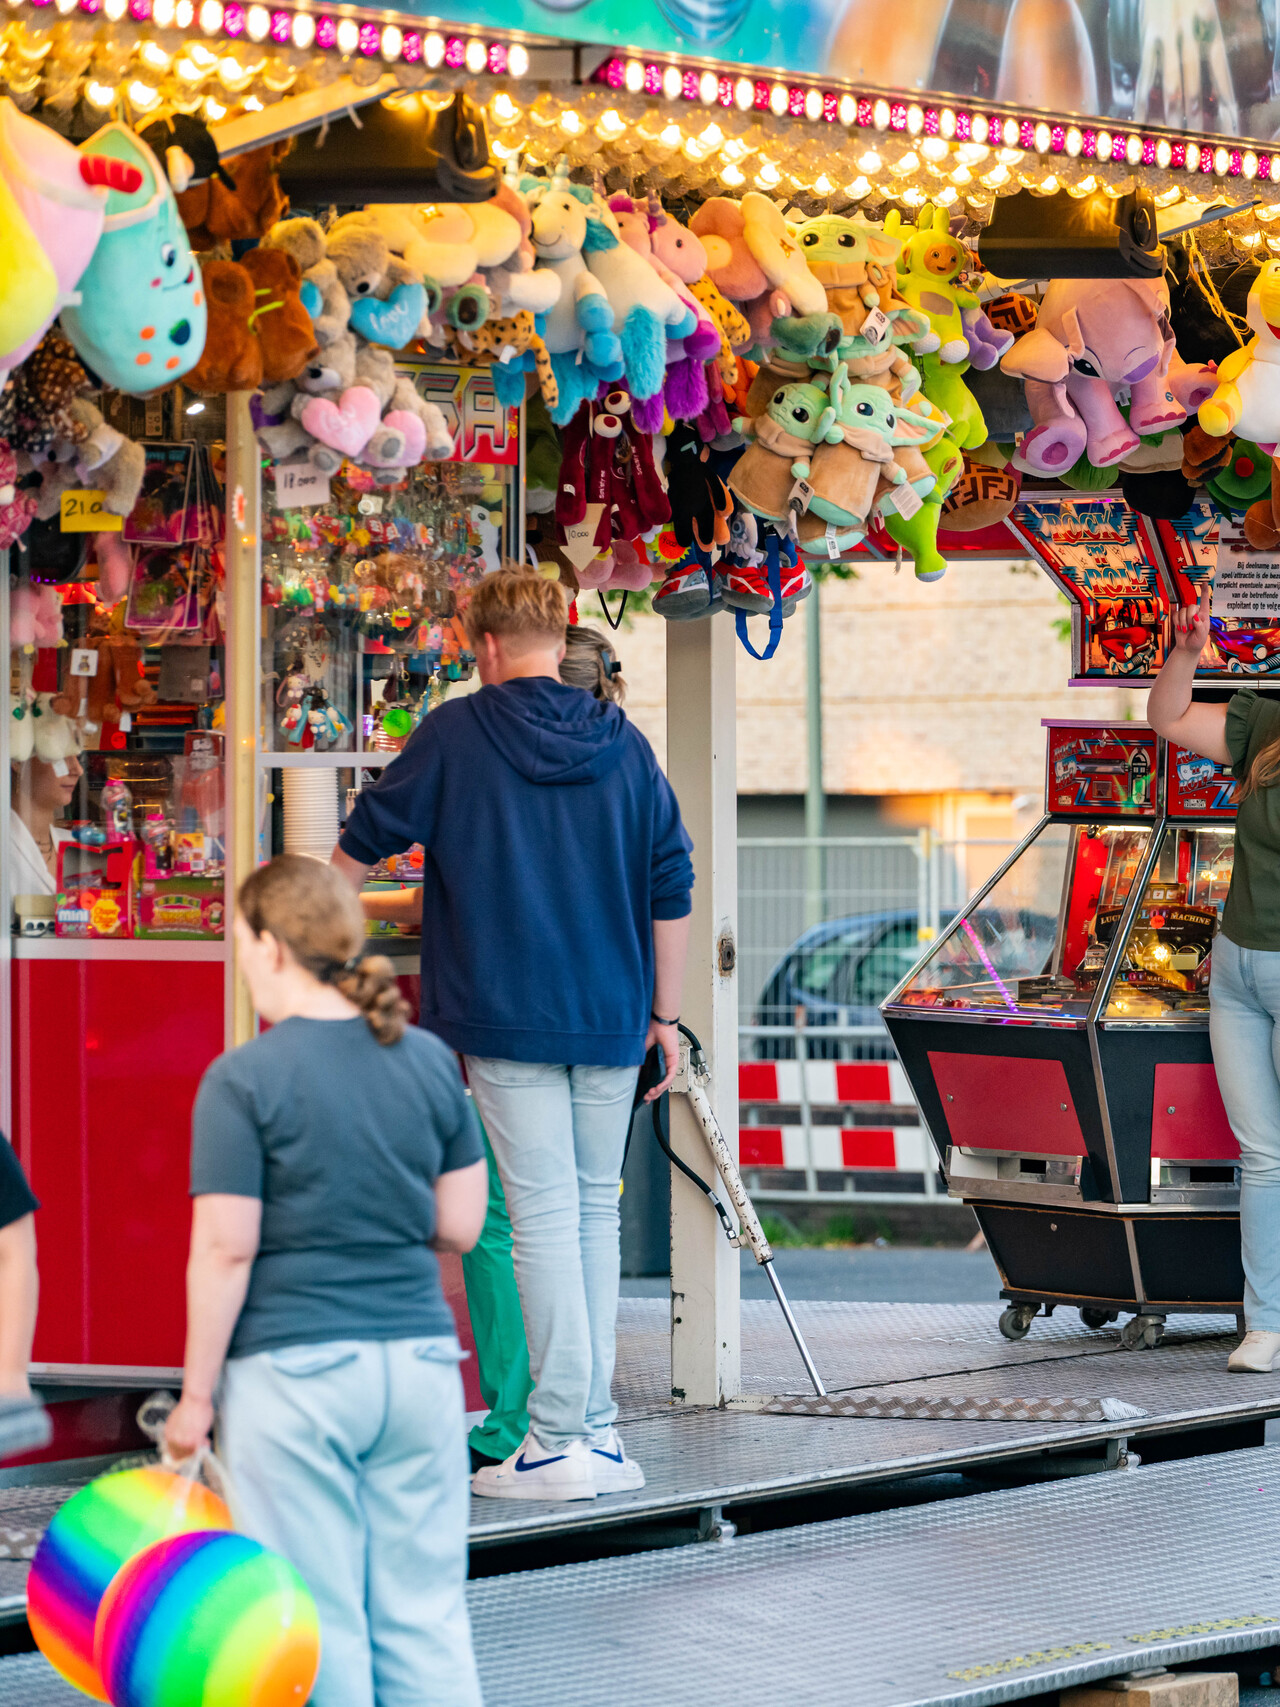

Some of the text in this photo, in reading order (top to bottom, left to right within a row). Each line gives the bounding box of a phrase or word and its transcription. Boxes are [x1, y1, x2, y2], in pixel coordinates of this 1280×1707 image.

[1043, 510, 1131, 546] ROCK
[1236, 562, 1245, 570] Bij
[1084, 560, 1153, 600] ROLL
[1216, 582, 1238, 590] verplicht
[1227, 602, 1251, 610] exploitant
[1178, 771, 1214, 795] ROLL
[57, 908, 89, 922] mini
[1170, 911, 1212, 926] MACHINE
